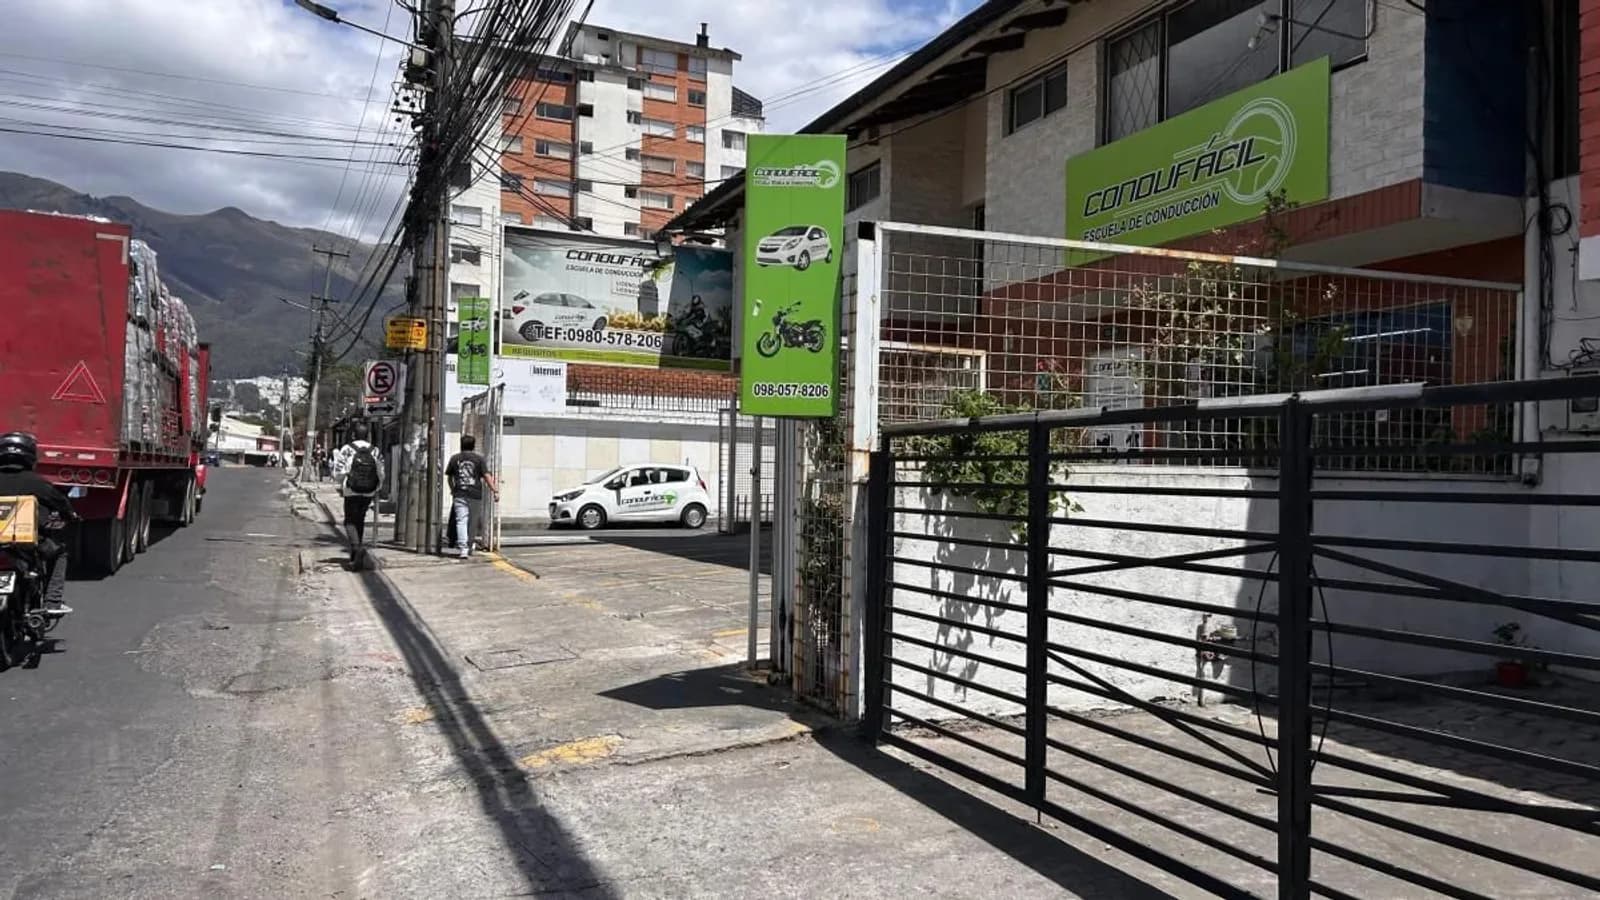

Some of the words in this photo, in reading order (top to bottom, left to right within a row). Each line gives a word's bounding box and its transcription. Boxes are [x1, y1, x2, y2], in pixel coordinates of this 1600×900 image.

[1084, 135, 1265, 216] CONDUFÁCIL
[1083, 220, 1127, 241] ESCUELA
[1128, 214, 1143, 230] DE
[1145, 190, 1220, 225] CONDUCCIÓN
[532, 365, 562, 376] Internet
[753, 383, 830, 398] 098-057-8206
